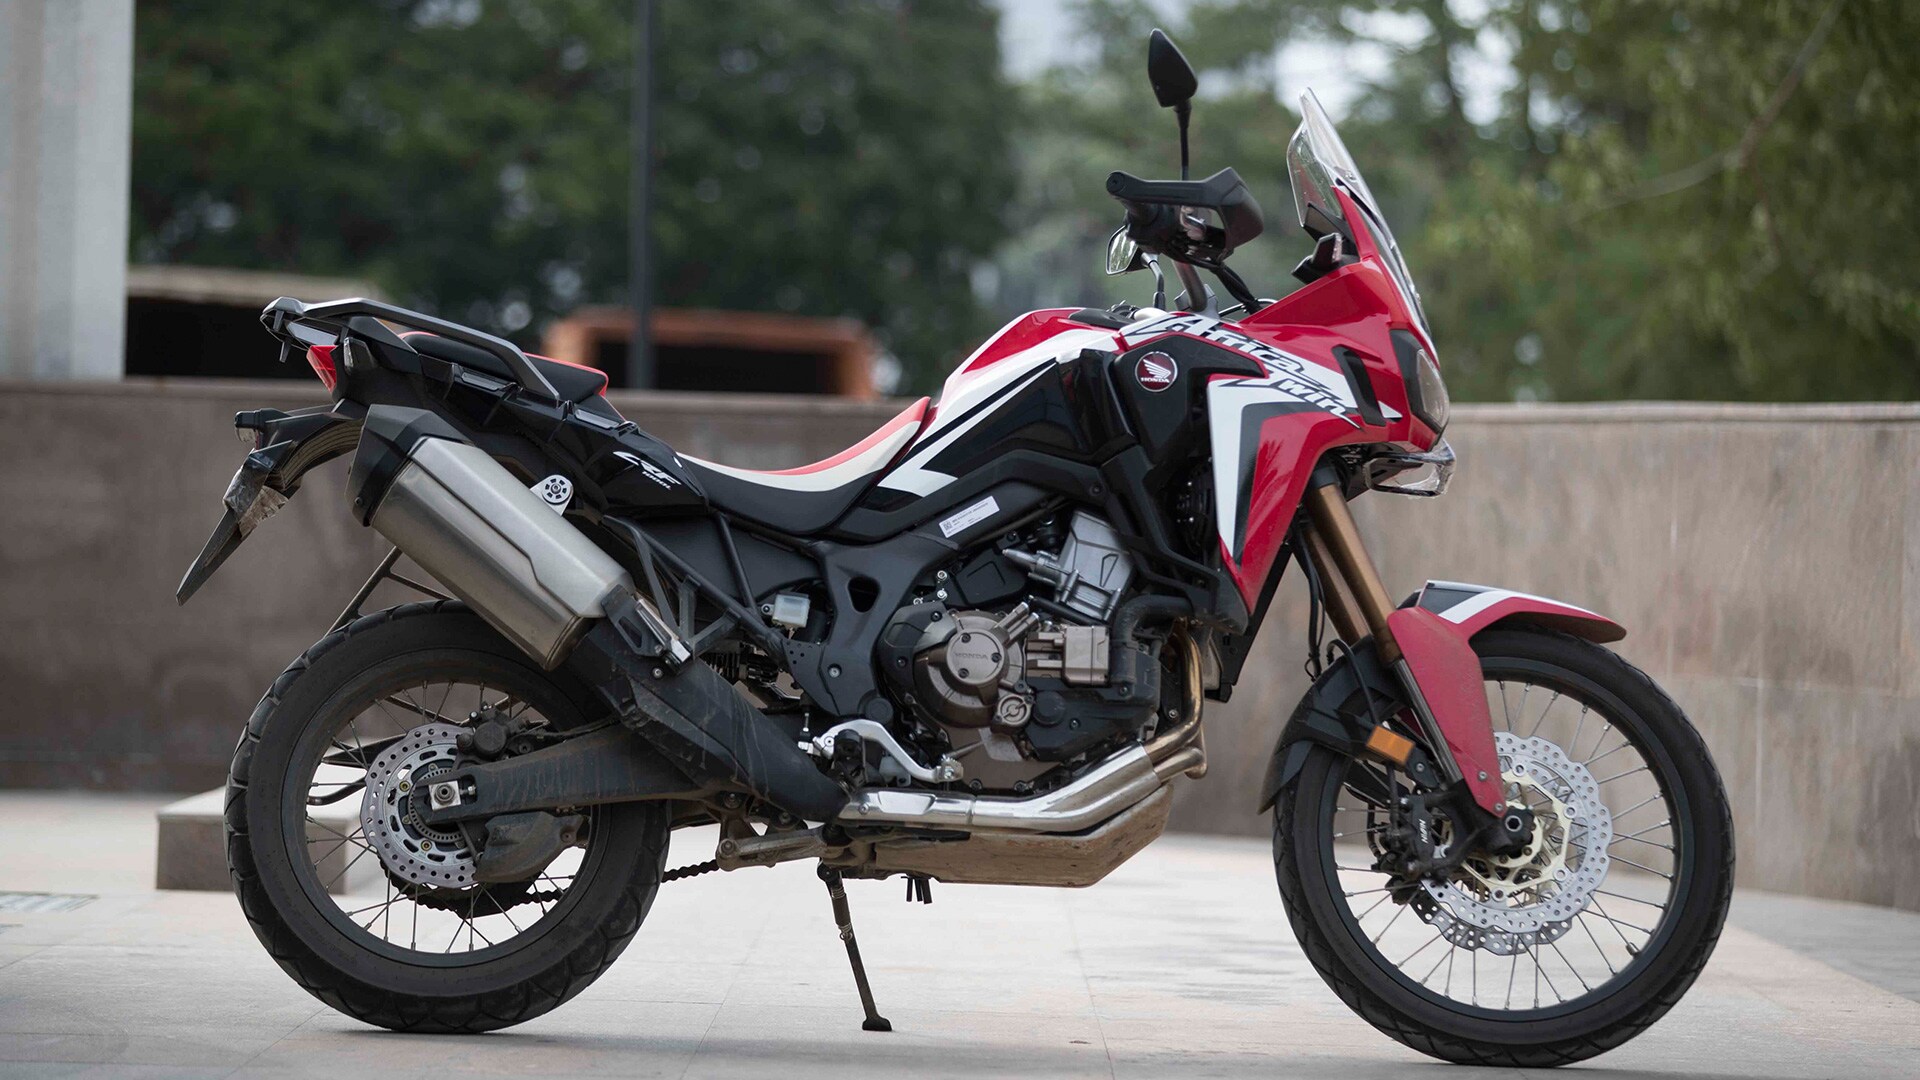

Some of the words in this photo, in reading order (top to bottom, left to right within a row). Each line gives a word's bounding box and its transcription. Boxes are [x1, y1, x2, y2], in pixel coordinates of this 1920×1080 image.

[1124, 312, 1306, 376] Africa
[1219, 370, 1362, 430] Twin
[612, 450, 682, 486] CRF
[953, 652, 989, 661] HONDA
